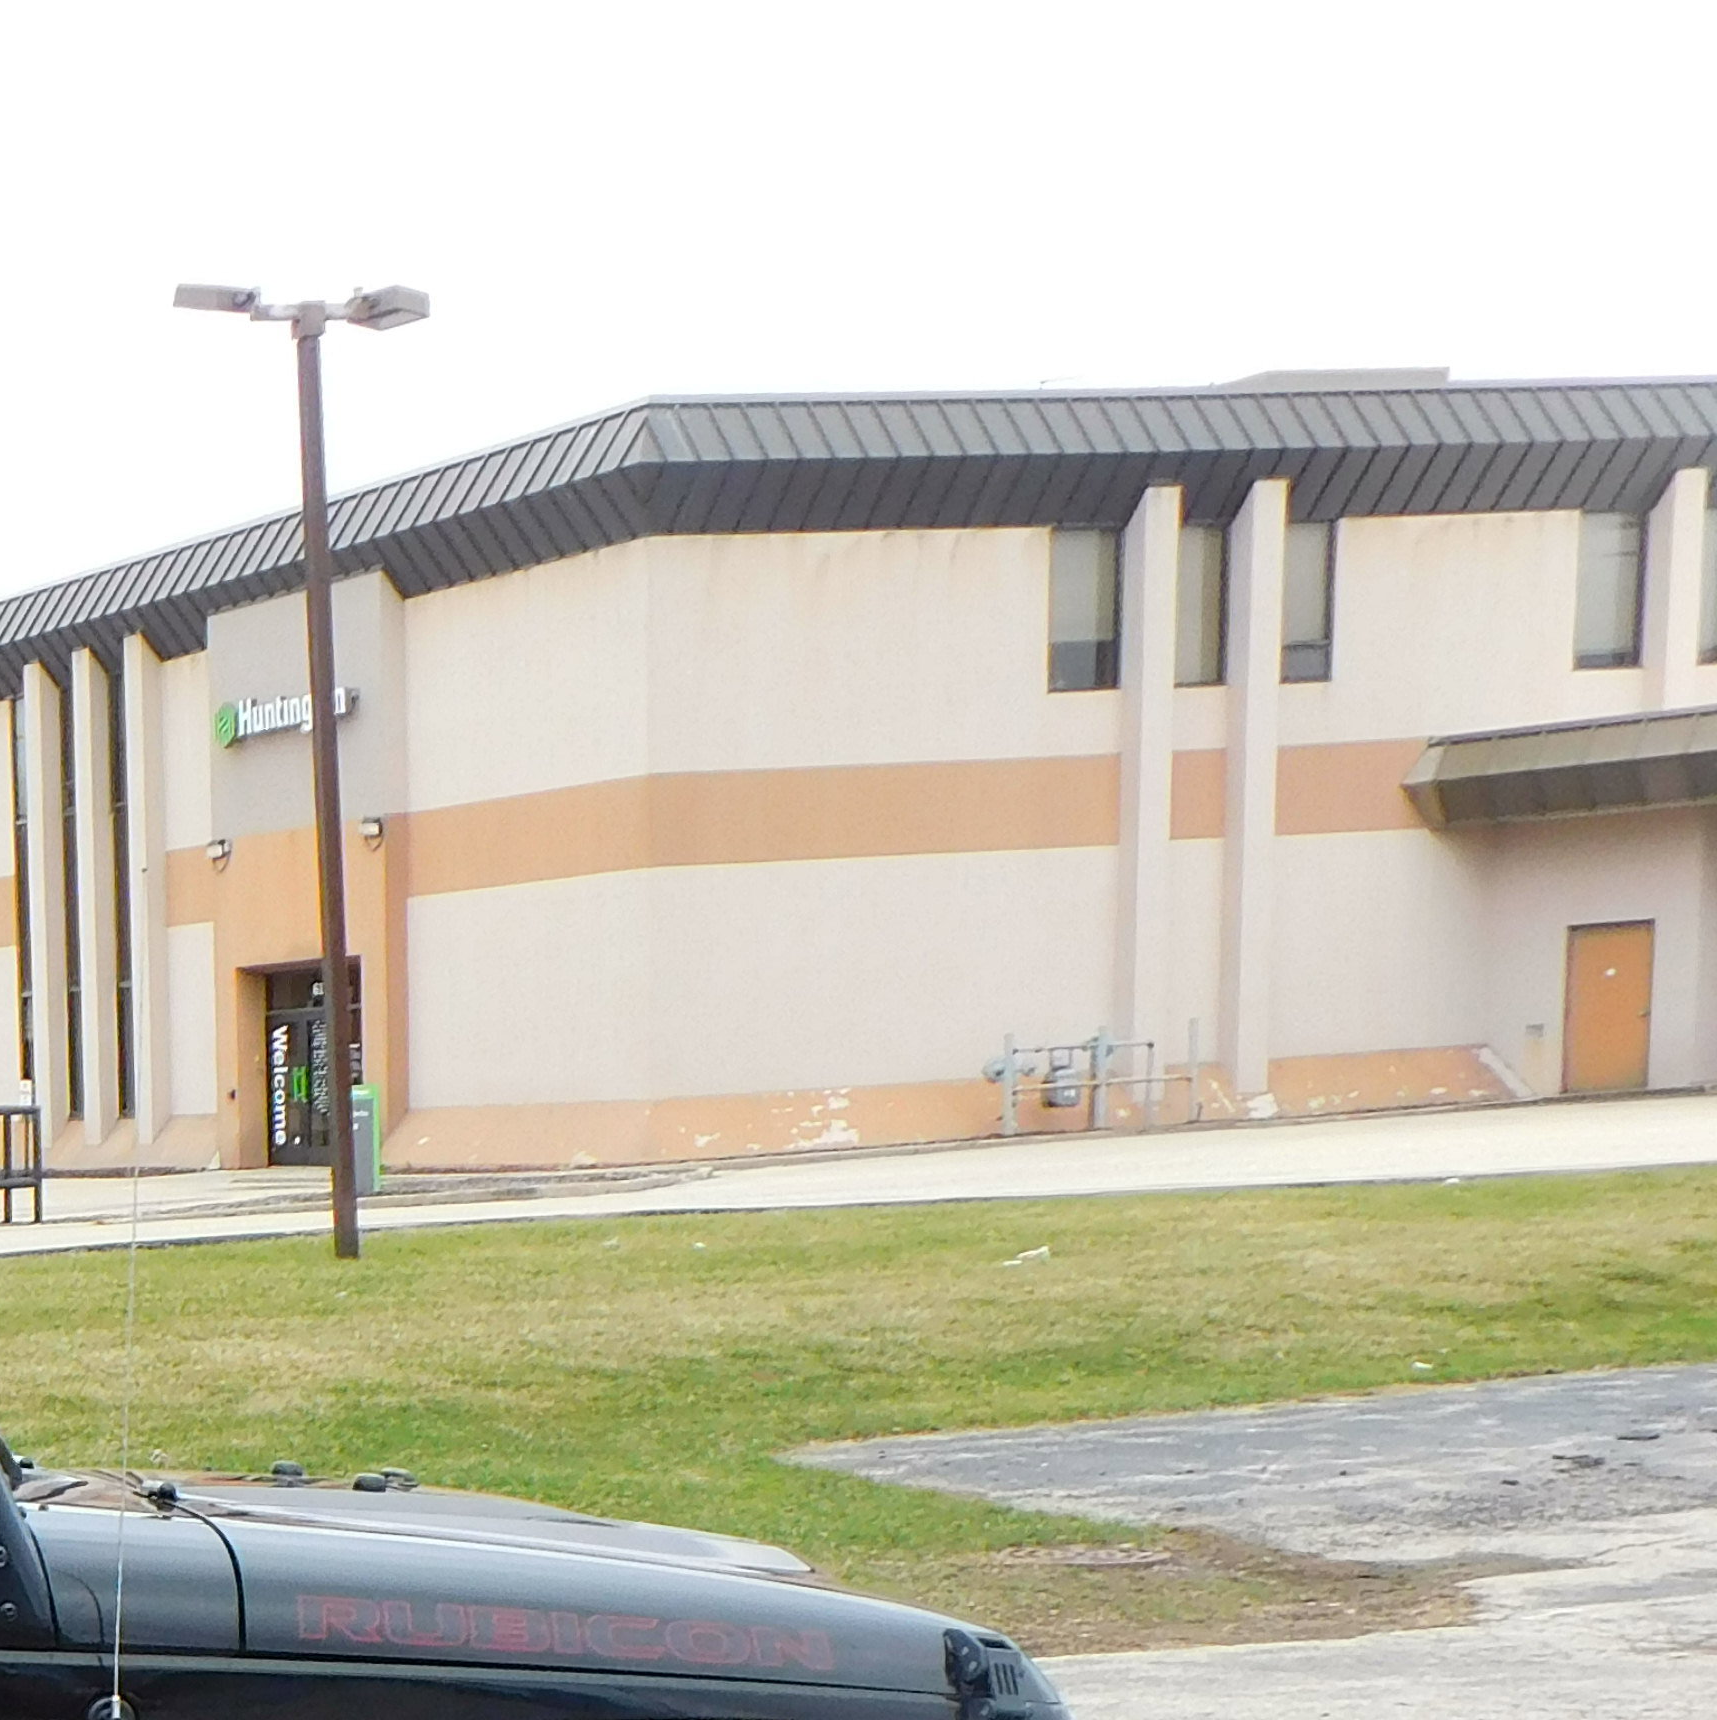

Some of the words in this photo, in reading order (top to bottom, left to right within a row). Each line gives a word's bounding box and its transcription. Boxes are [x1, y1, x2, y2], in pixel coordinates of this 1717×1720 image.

[237, 687, 346, 734] Huntingn
[271, 1025, 289, 1146] Welcome
[296, 1595, 834, 1670] RUBICON
